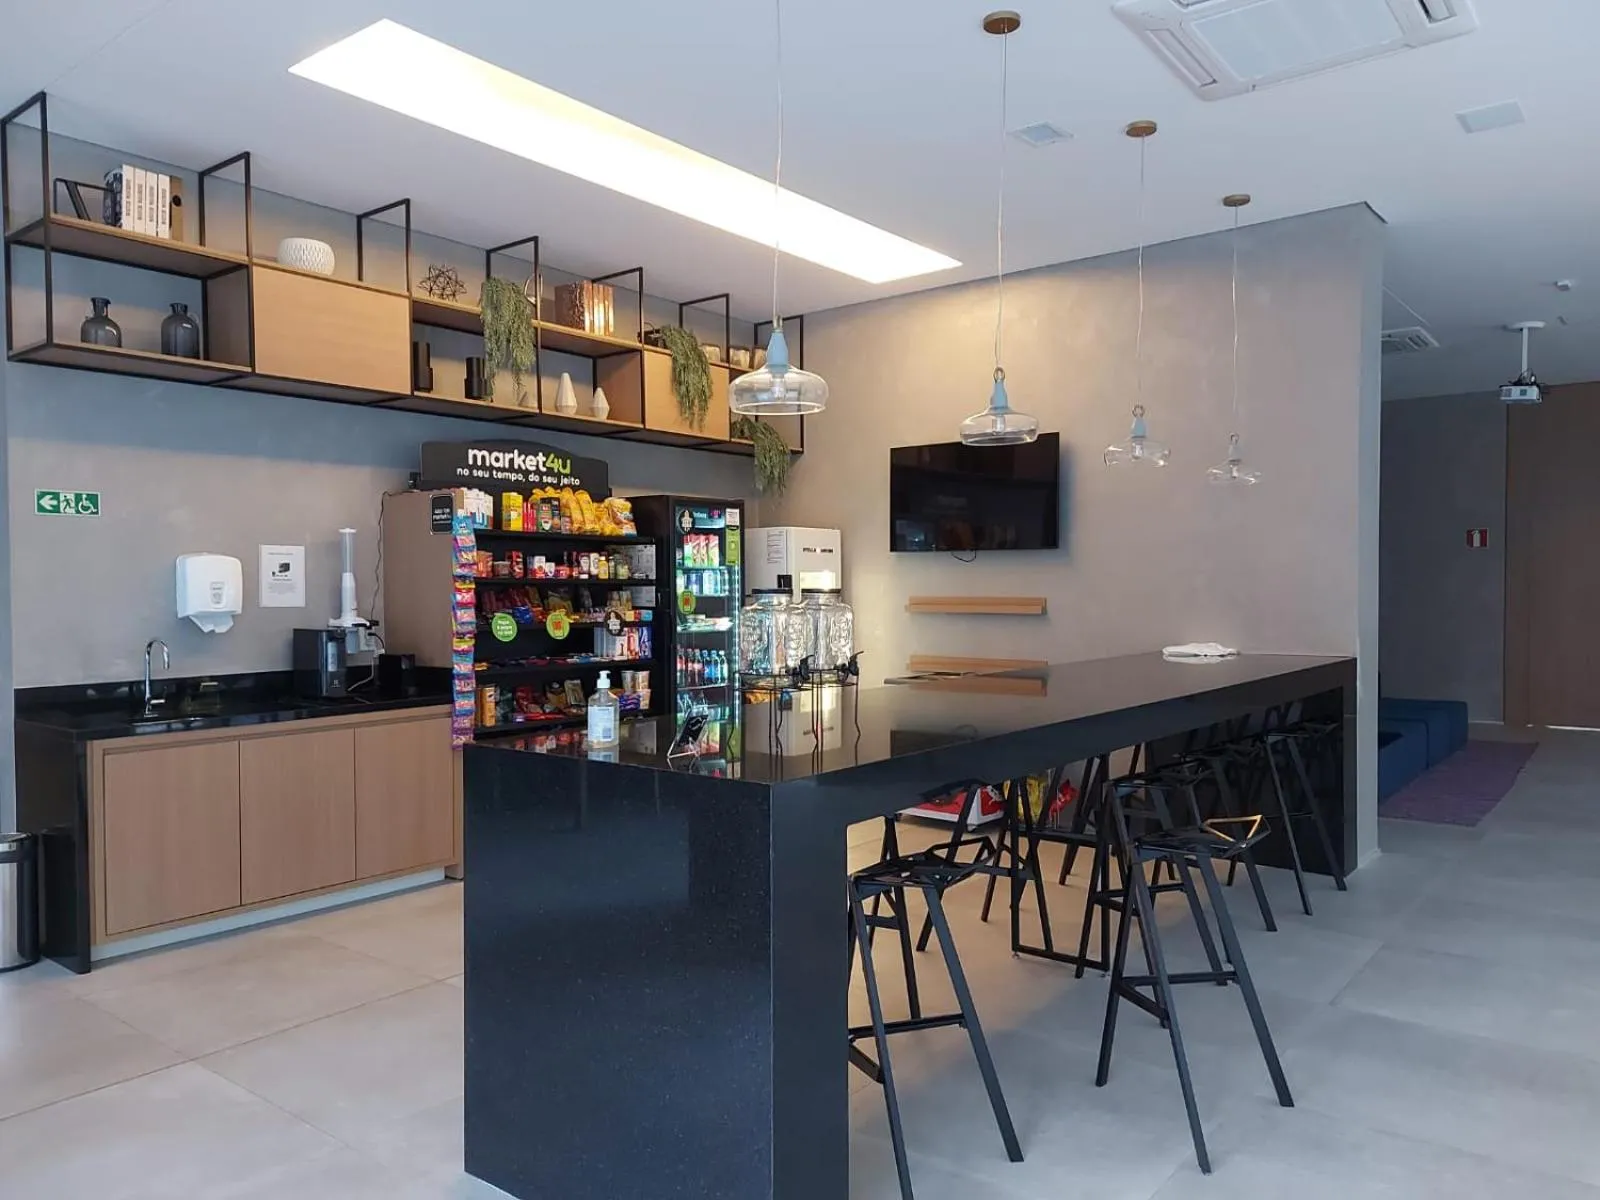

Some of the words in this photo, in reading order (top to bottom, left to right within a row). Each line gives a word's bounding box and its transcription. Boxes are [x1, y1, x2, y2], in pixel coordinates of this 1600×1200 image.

[467, 448, 572, 474] market4u
[456, 467, 470, 476] no
[472, 469, 489, 478] seu
[492, 470, 526, 482] tempo,
[528, 473, 540, 482] do
[542, 475, 558, 484] seu
[559, 474, 580, 486] jeito
